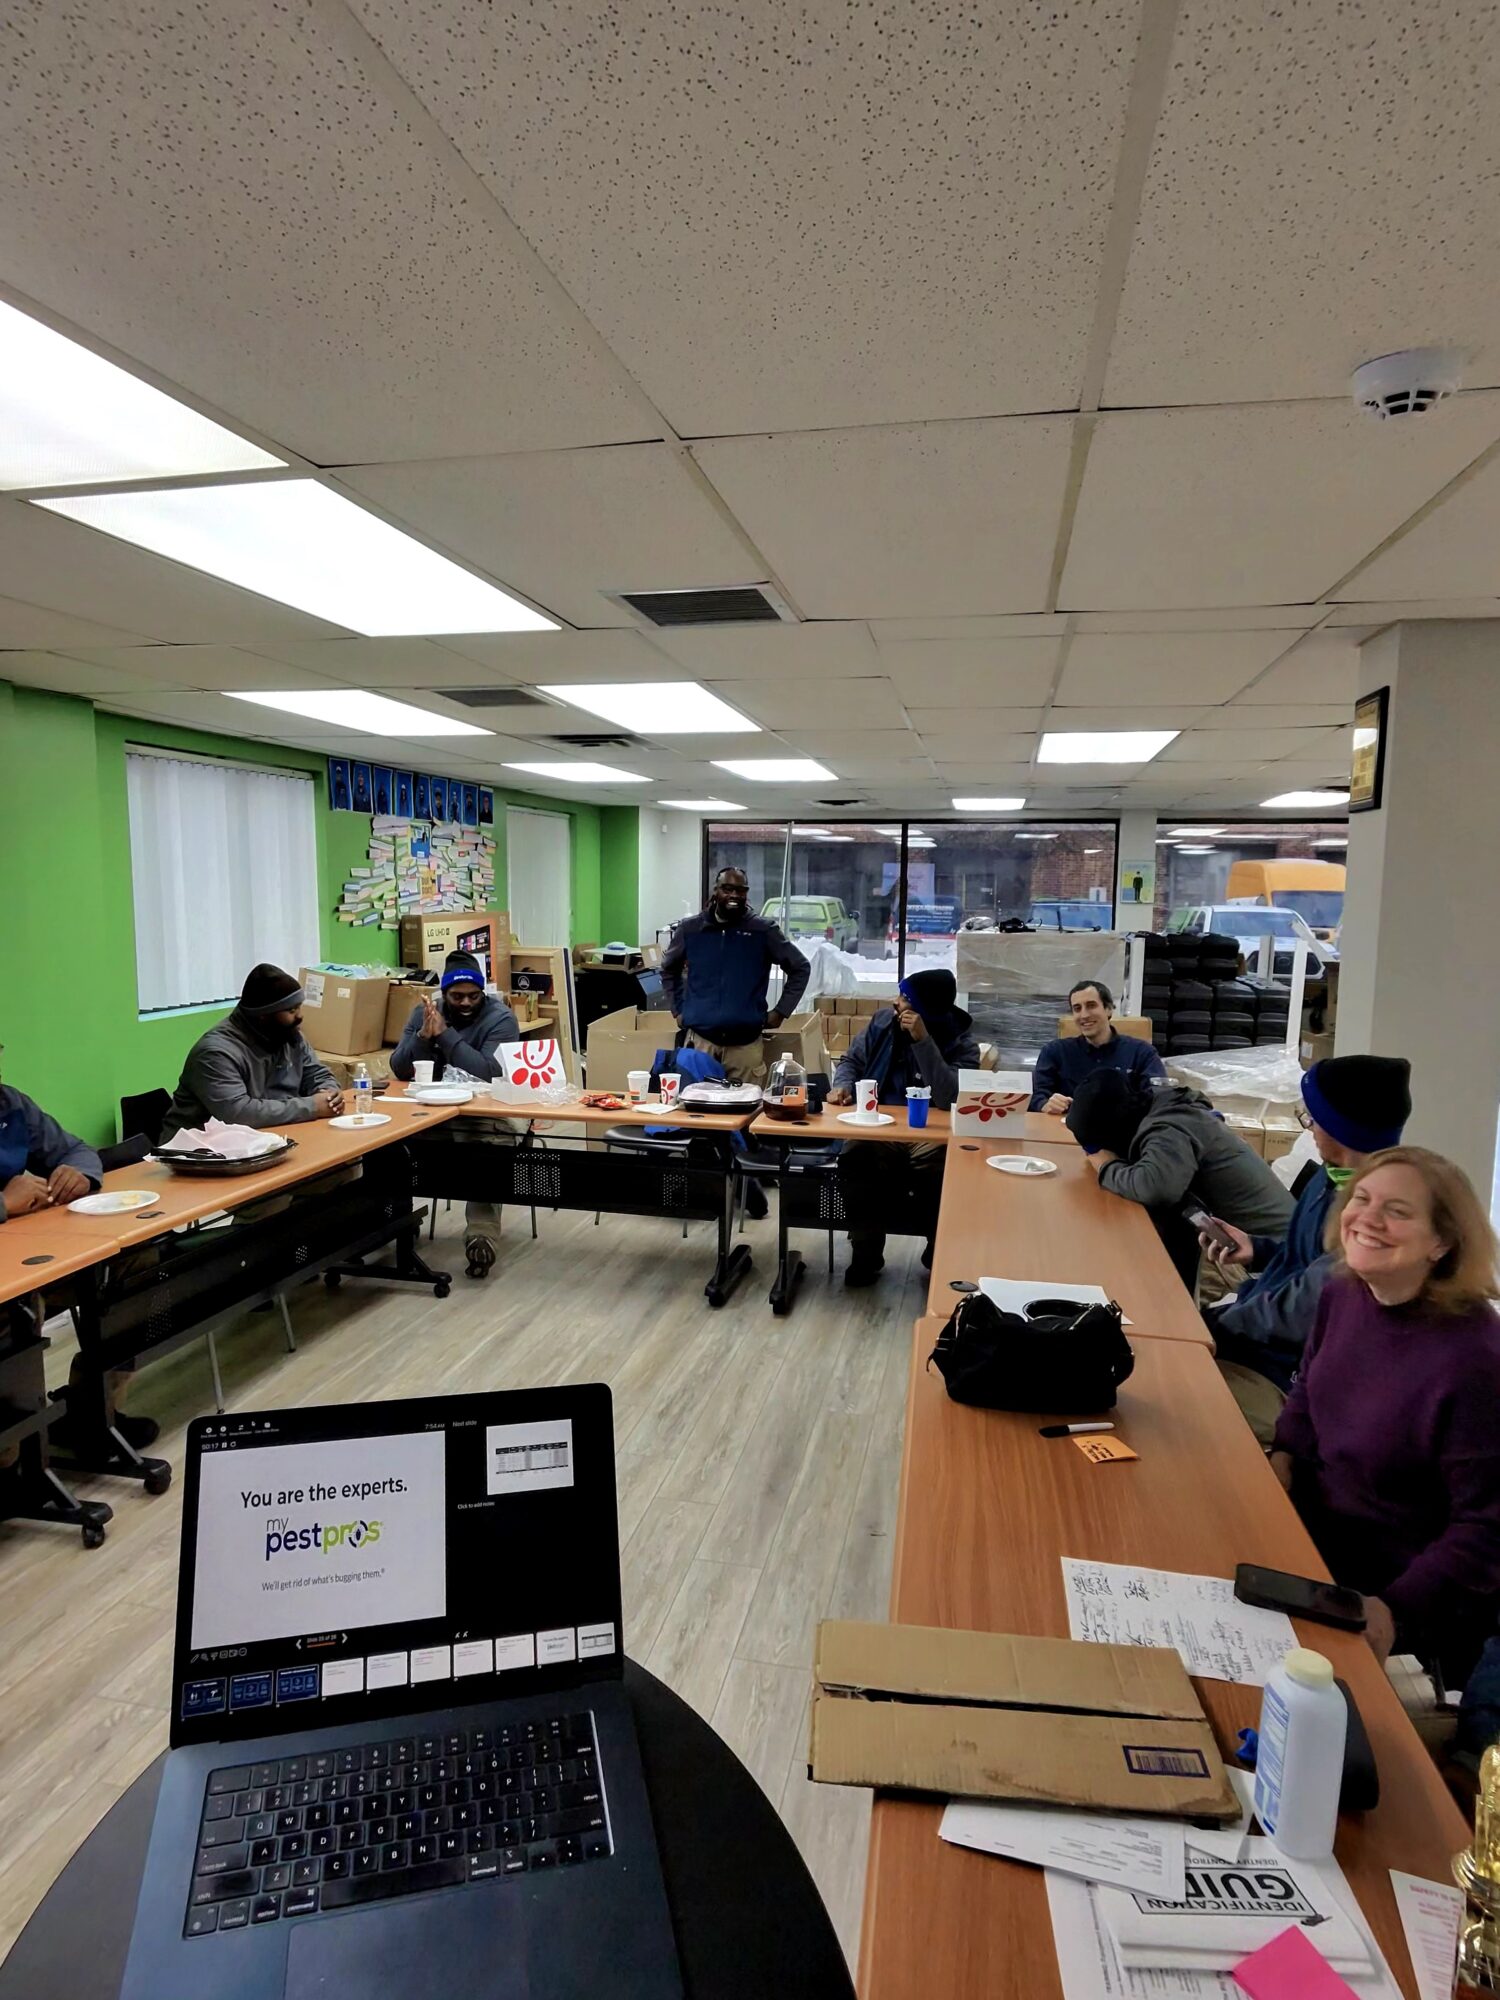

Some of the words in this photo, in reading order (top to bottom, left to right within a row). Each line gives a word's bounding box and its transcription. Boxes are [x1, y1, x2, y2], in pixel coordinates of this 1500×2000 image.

[427, 929, 434, 937] LG
[241, 1491, 272, 1509] You
[277, 1489, 304, 1505] are
[309, 1483, 337, 1501] the
[341, 1477, 408, 1500] experts.
[266, 1517, 290, 1534] my
[265, 1520, 381, 1561] pestpros
[262, 1581, 280, 1591] We'll
[280, 1581, 292, 1591] get
[293, 1578, 303, 1588] rid
[303, 1577, 312, 1587] of
[312, 1574, 334, 1586] what's
[335, 1571, 362, 1583] bugging
[303, 1793, 308, 1801] 3
[291, 1842, 297, 1850] S
[320, 1837, 327, 1845] D
[377, 1826, 384, 1834] G
[274, 1872, 280, 1881] Z
[333, 1862, 339, 1870] C
[363, 1856, 368, 1864] V
[391, 1851, 397, 1859] B
[447, 1840, 454, 1848] M
[1186, 1857, 1227, 1865] ONTROL
[1186, 1873, 1294, 1900] GUID
[257, 1909, 275, 1918] option
